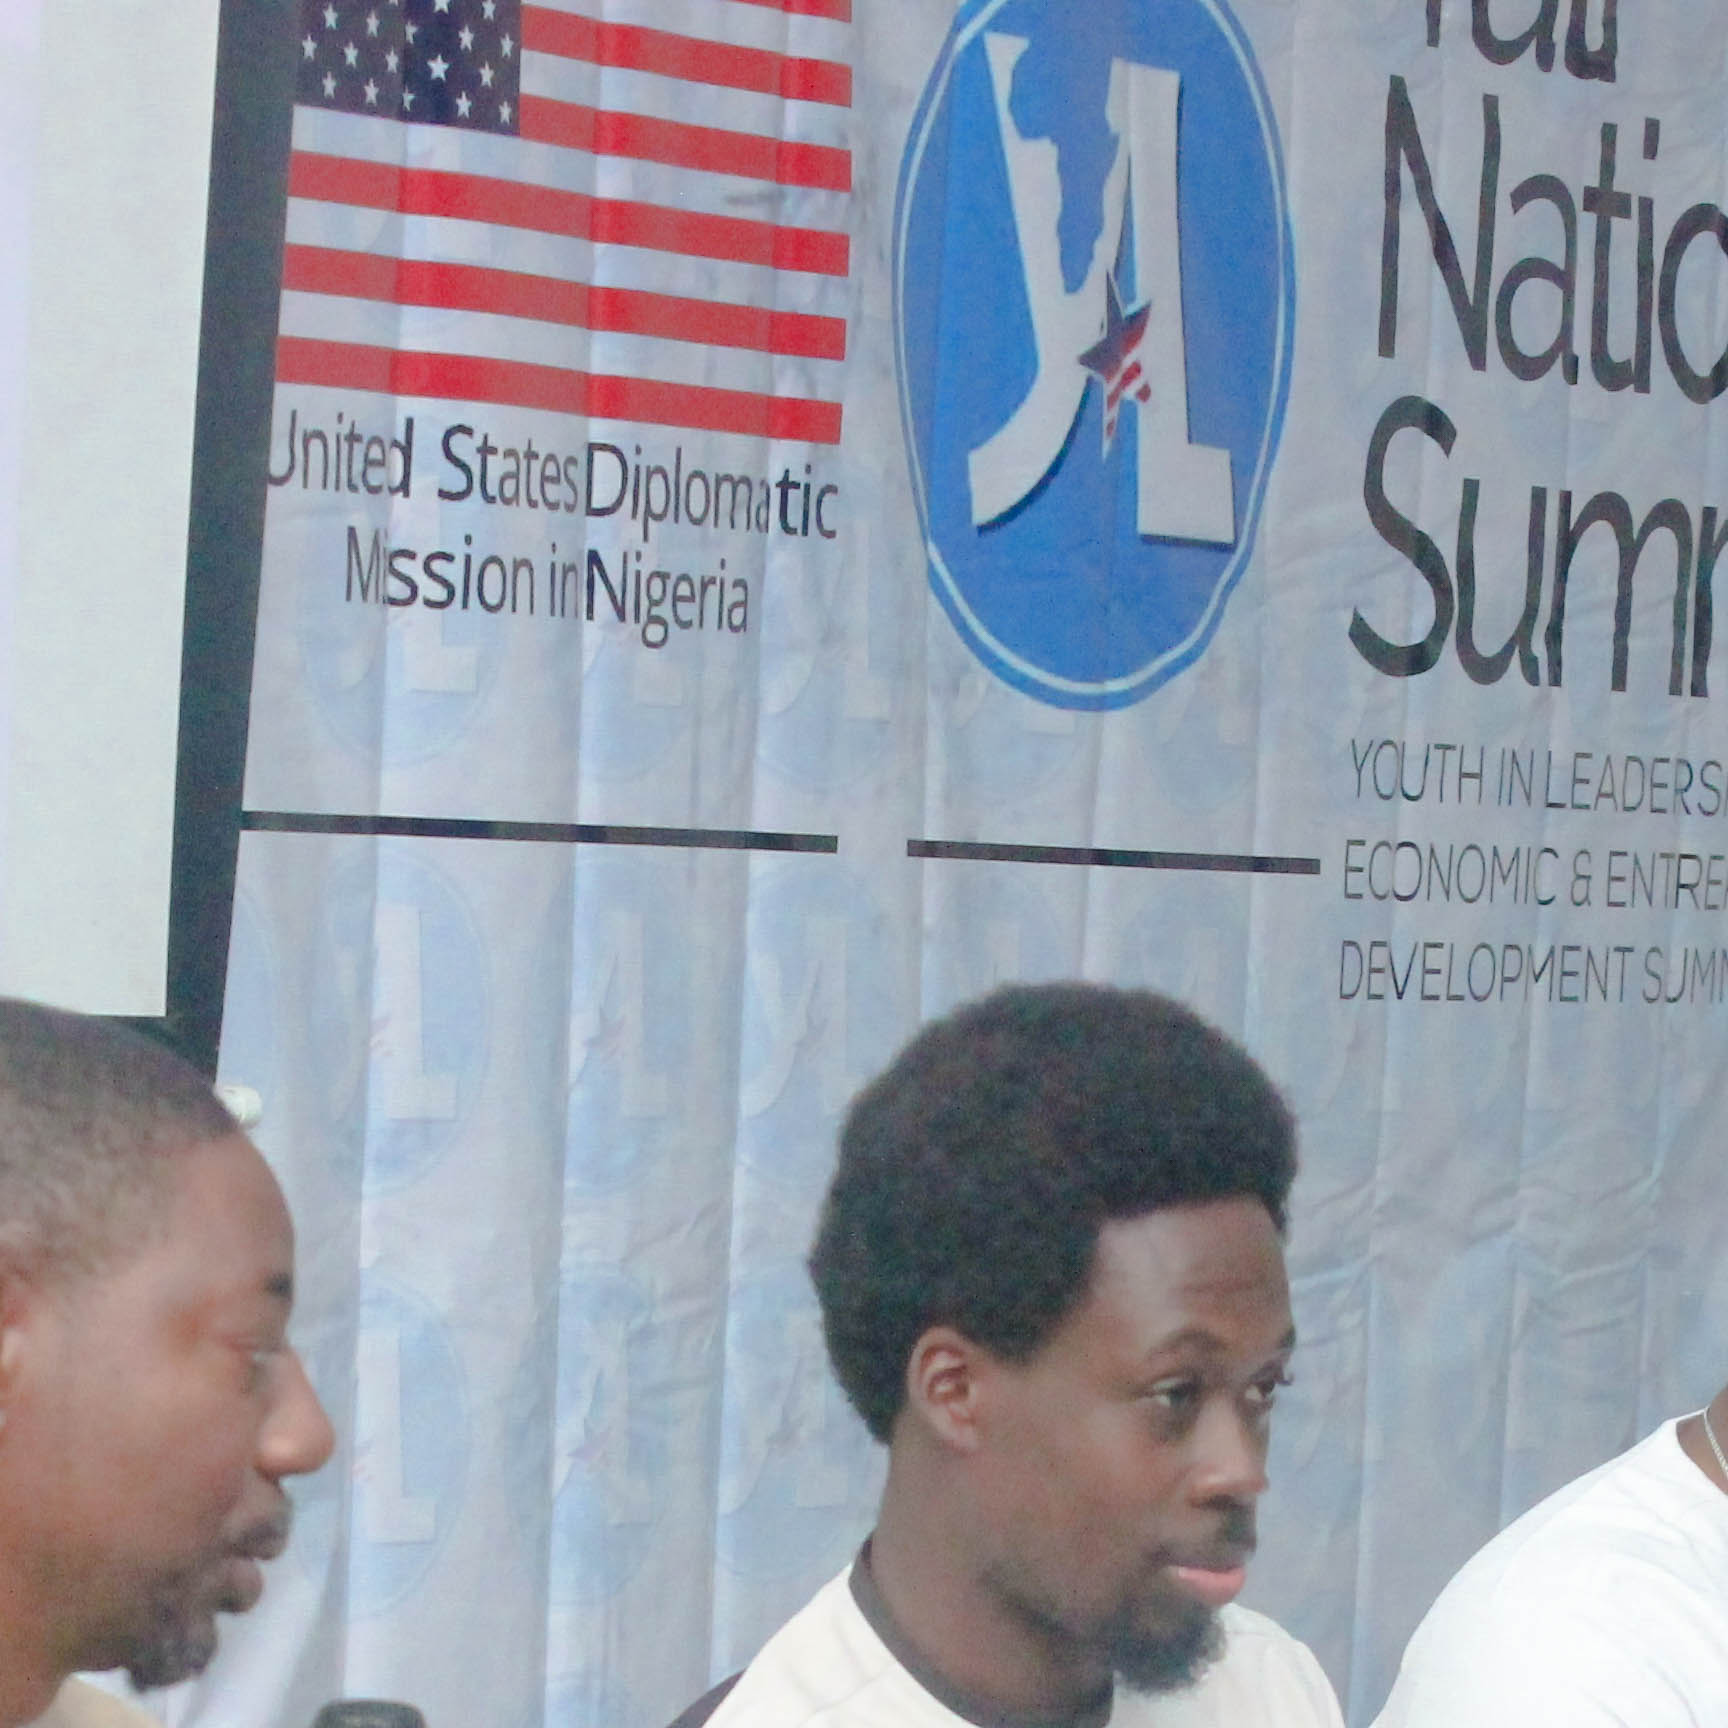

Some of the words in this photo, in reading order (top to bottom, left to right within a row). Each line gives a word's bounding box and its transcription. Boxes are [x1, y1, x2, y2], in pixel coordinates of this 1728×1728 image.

[437, 422, 580, 513] States
[584, 440, 840, 544] Diplomatic
[547, 541, 579, 619] in
[585, 548, 749, 650] Nigeria
[1351, 737, 1485, 804] YOUTH
[1497, 746, 1535, 808] IN
[1343, 838, 1560, 907] ECONOMIC
[1570, 848, 1593, 907] &
[1338, 939, 1635, 1003] DEVELOPMENT
